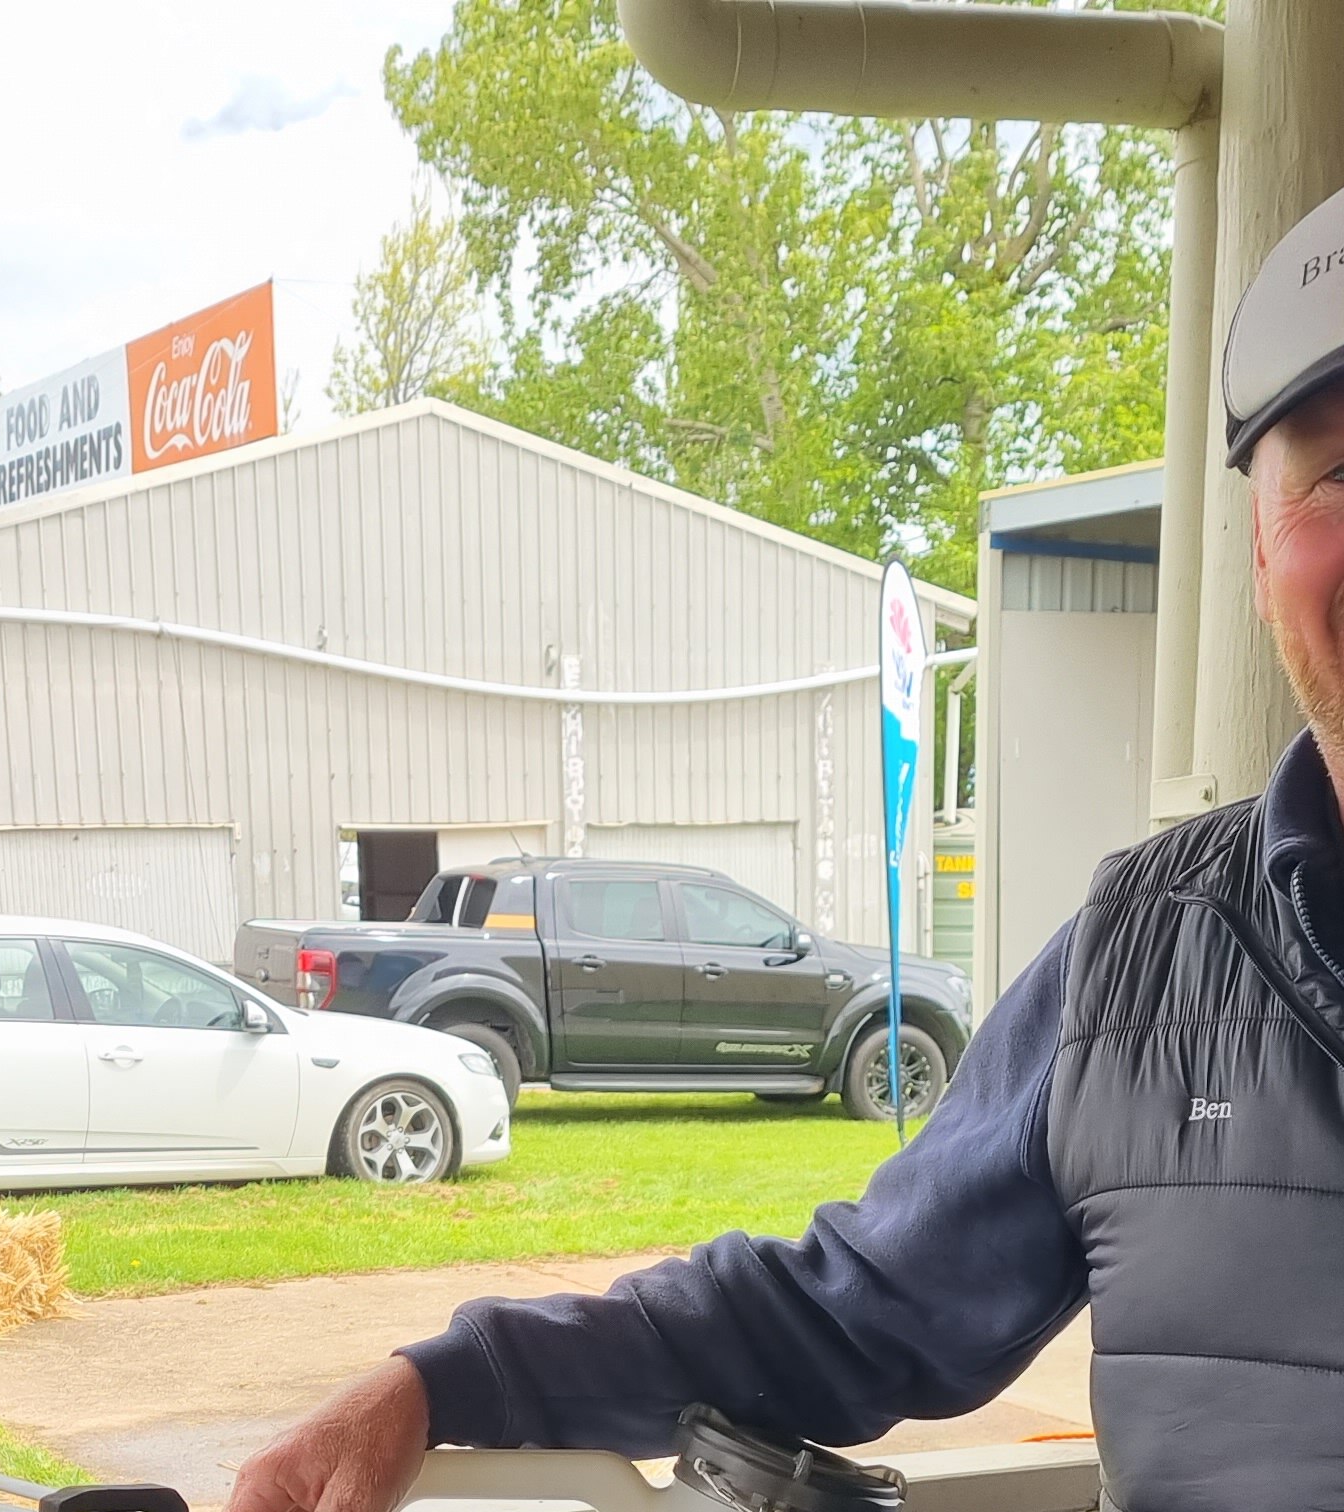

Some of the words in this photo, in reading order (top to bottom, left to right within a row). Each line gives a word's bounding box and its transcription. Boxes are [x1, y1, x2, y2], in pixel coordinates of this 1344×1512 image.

[6, 393, 51, 451] FOOD
[58, 374, 99, 433] AND
[143, 328, 254, 460] Coca-Cola
[1188, 1097, 1233, 1121] Ben
